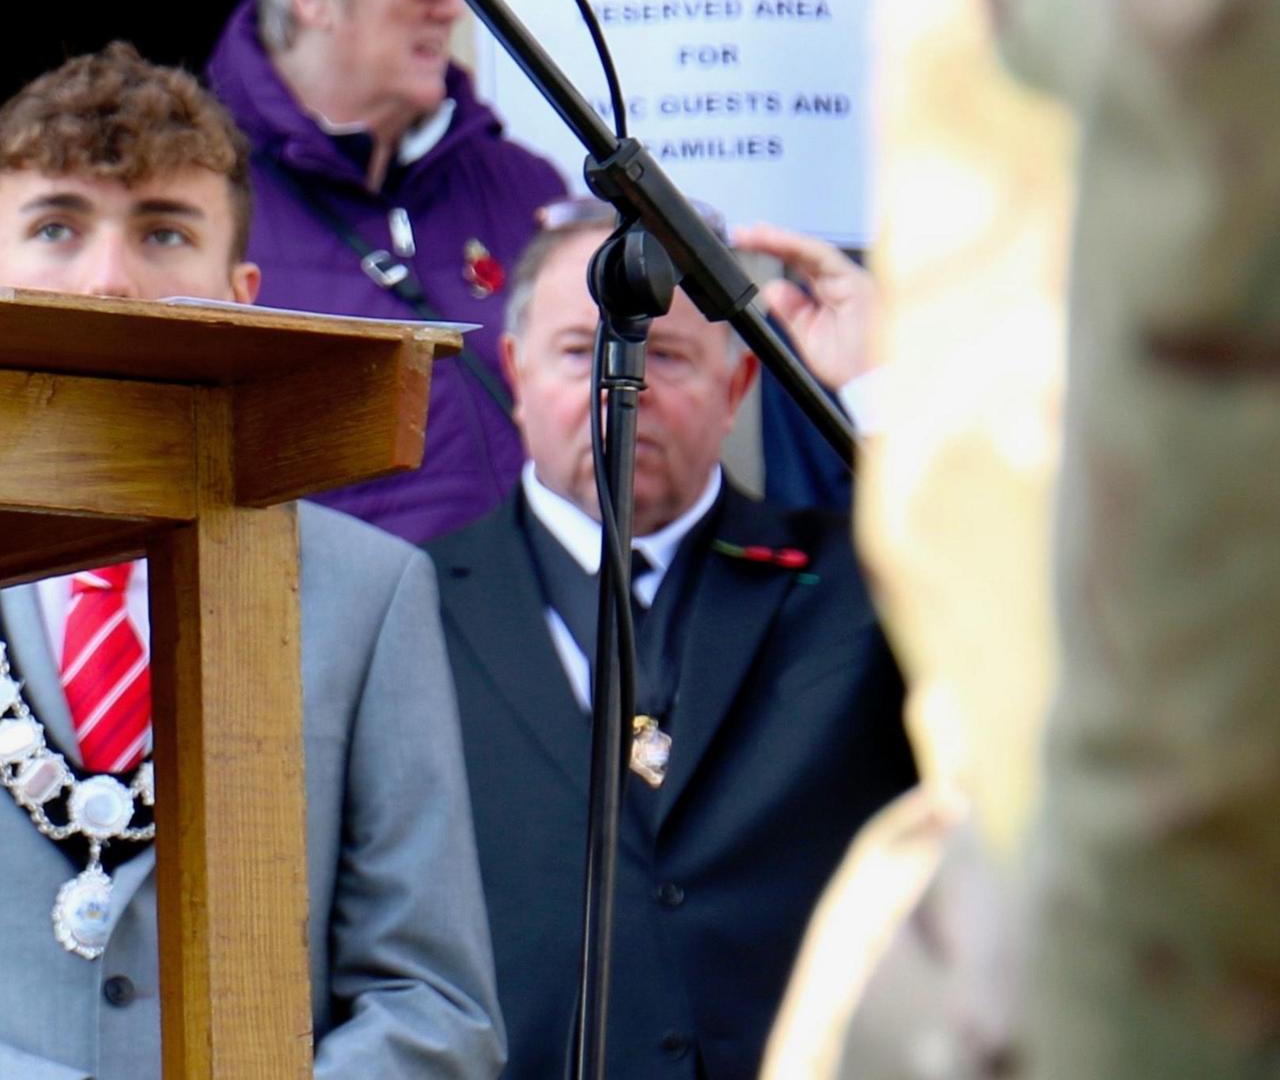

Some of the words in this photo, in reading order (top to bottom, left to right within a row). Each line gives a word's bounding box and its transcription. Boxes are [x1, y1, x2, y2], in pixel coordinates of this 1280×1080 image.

[677, 44, 739, 67] FOR
[658, 92, 782, 117] GUESTS
[792, 92, 851, 117] AND
